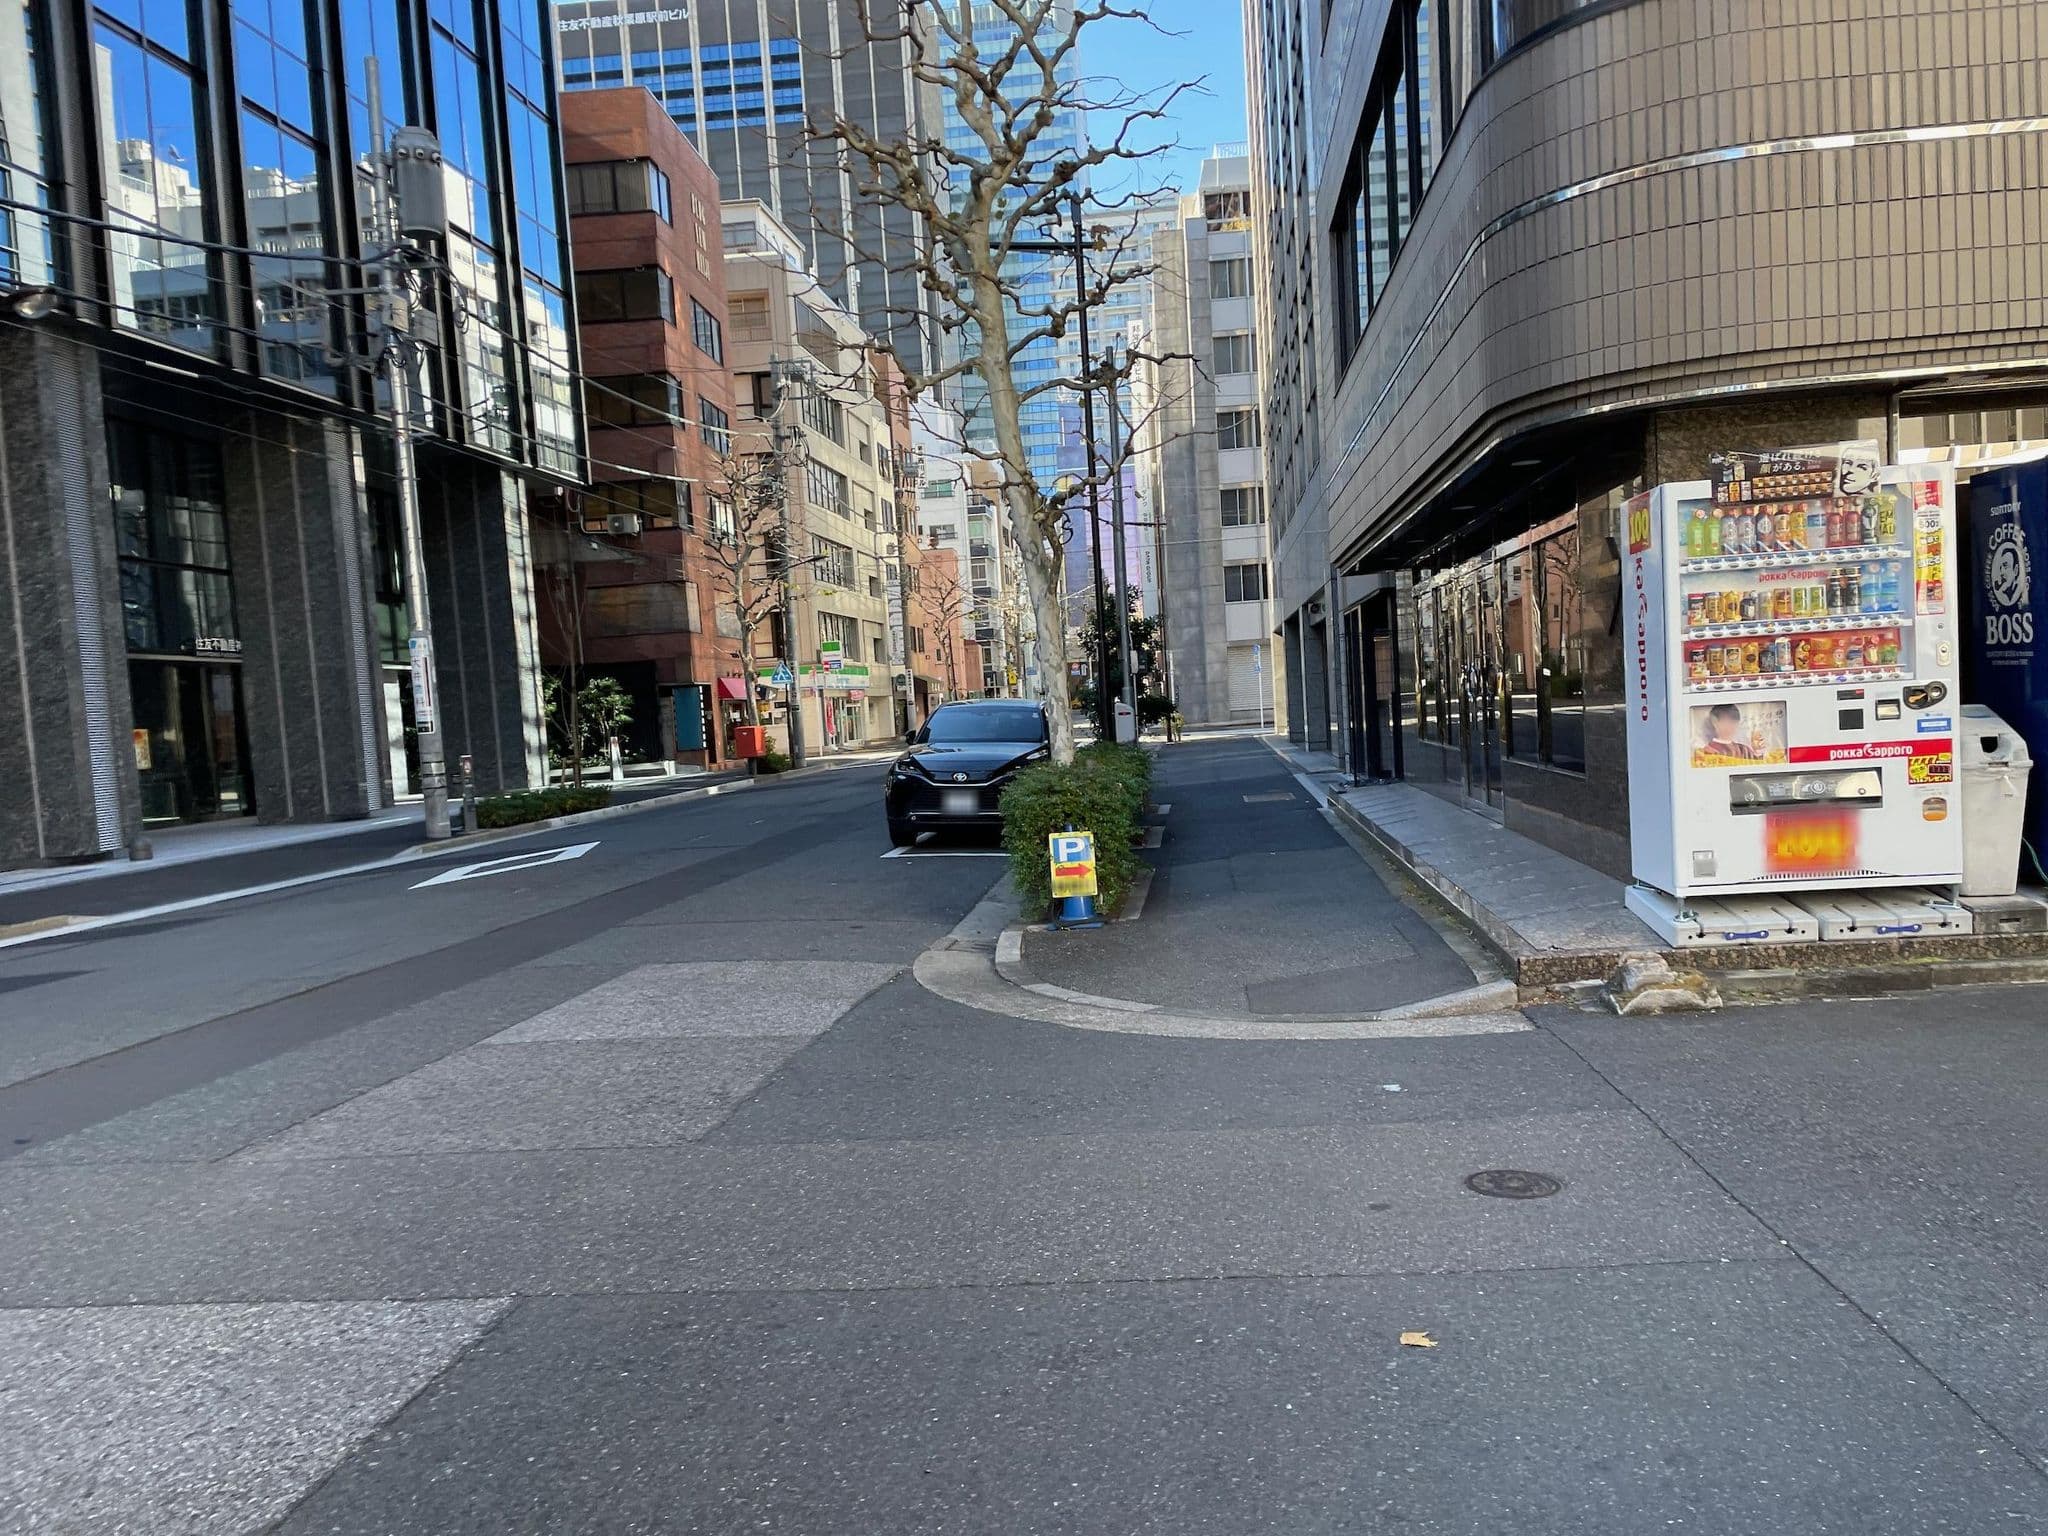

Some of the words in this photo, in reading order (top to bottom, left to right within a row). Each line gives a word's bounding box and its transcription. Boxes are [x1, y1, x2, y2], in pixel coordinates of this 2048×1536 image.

[1629, 508, 1649, 544] 100
[1985, 612, 2034, 645] BOSS
[1058, 838, 1085, 862] P
